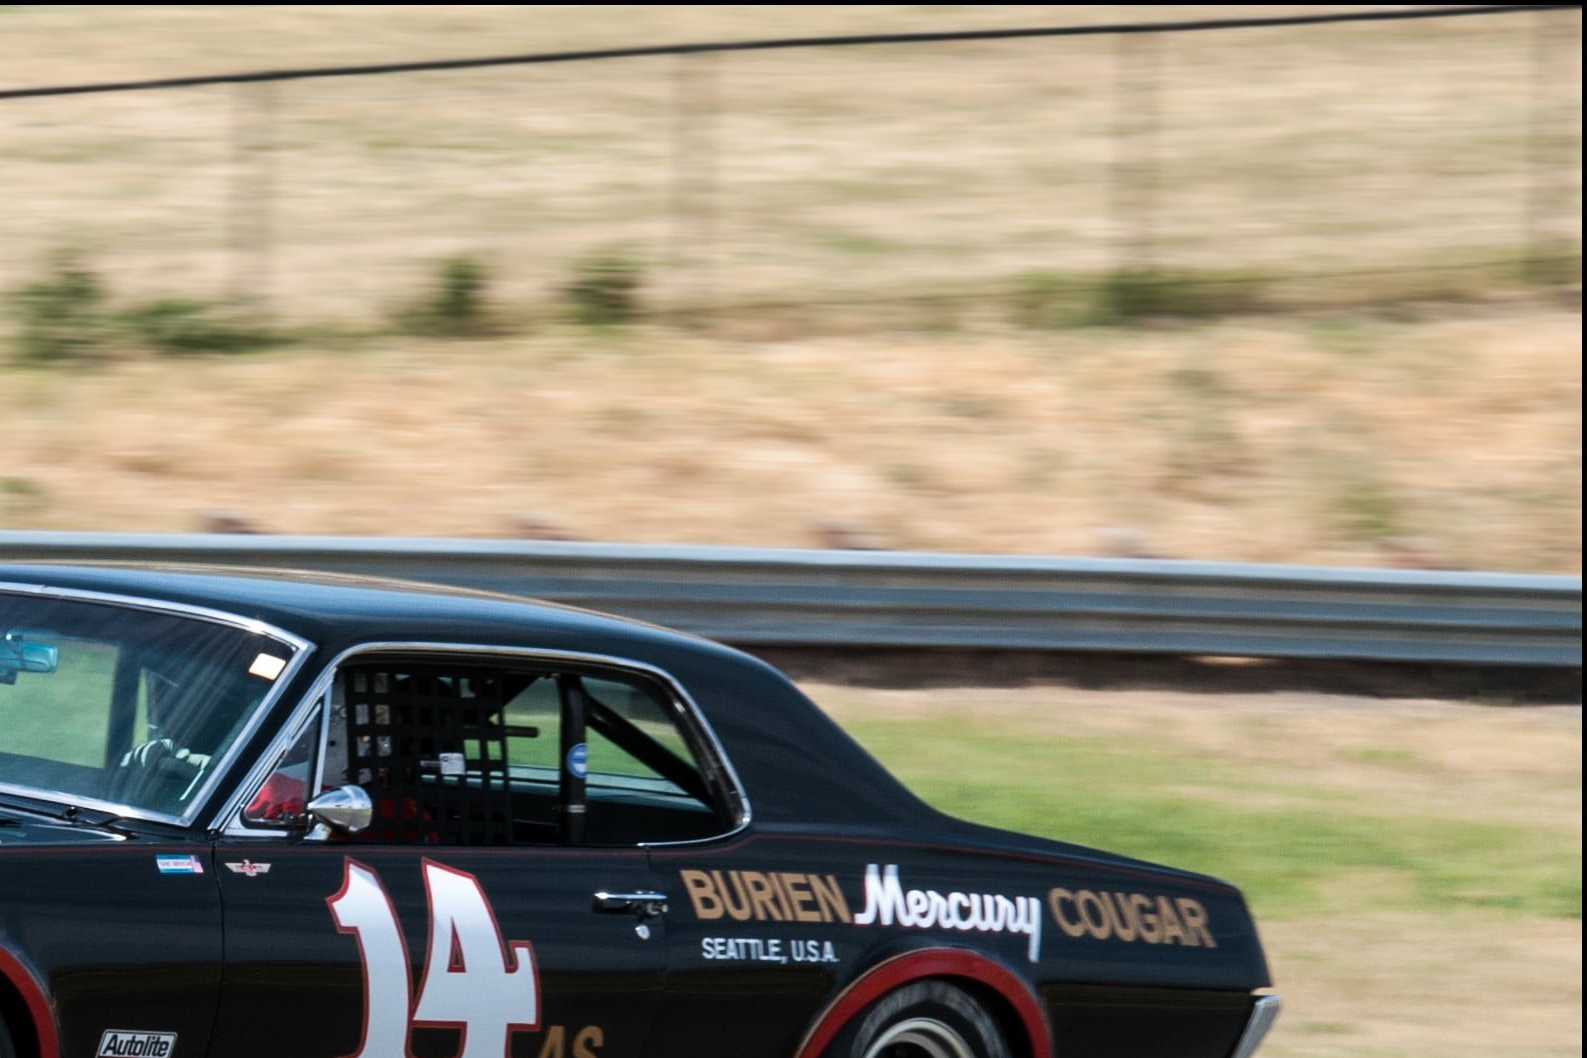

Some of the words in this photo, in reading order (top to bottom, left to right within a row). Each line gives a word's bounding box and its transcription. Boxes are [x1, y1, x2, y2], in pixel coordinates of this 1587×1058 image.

[679, 869, 853, 923] BURIEN
[853, 863, 1041, 963] Mercury
[1049, 887, 1216, 947] COUGAR
[701, 937, 789, 964] SEATTLE,
[103, 1034, 169, 1057] Autolite
